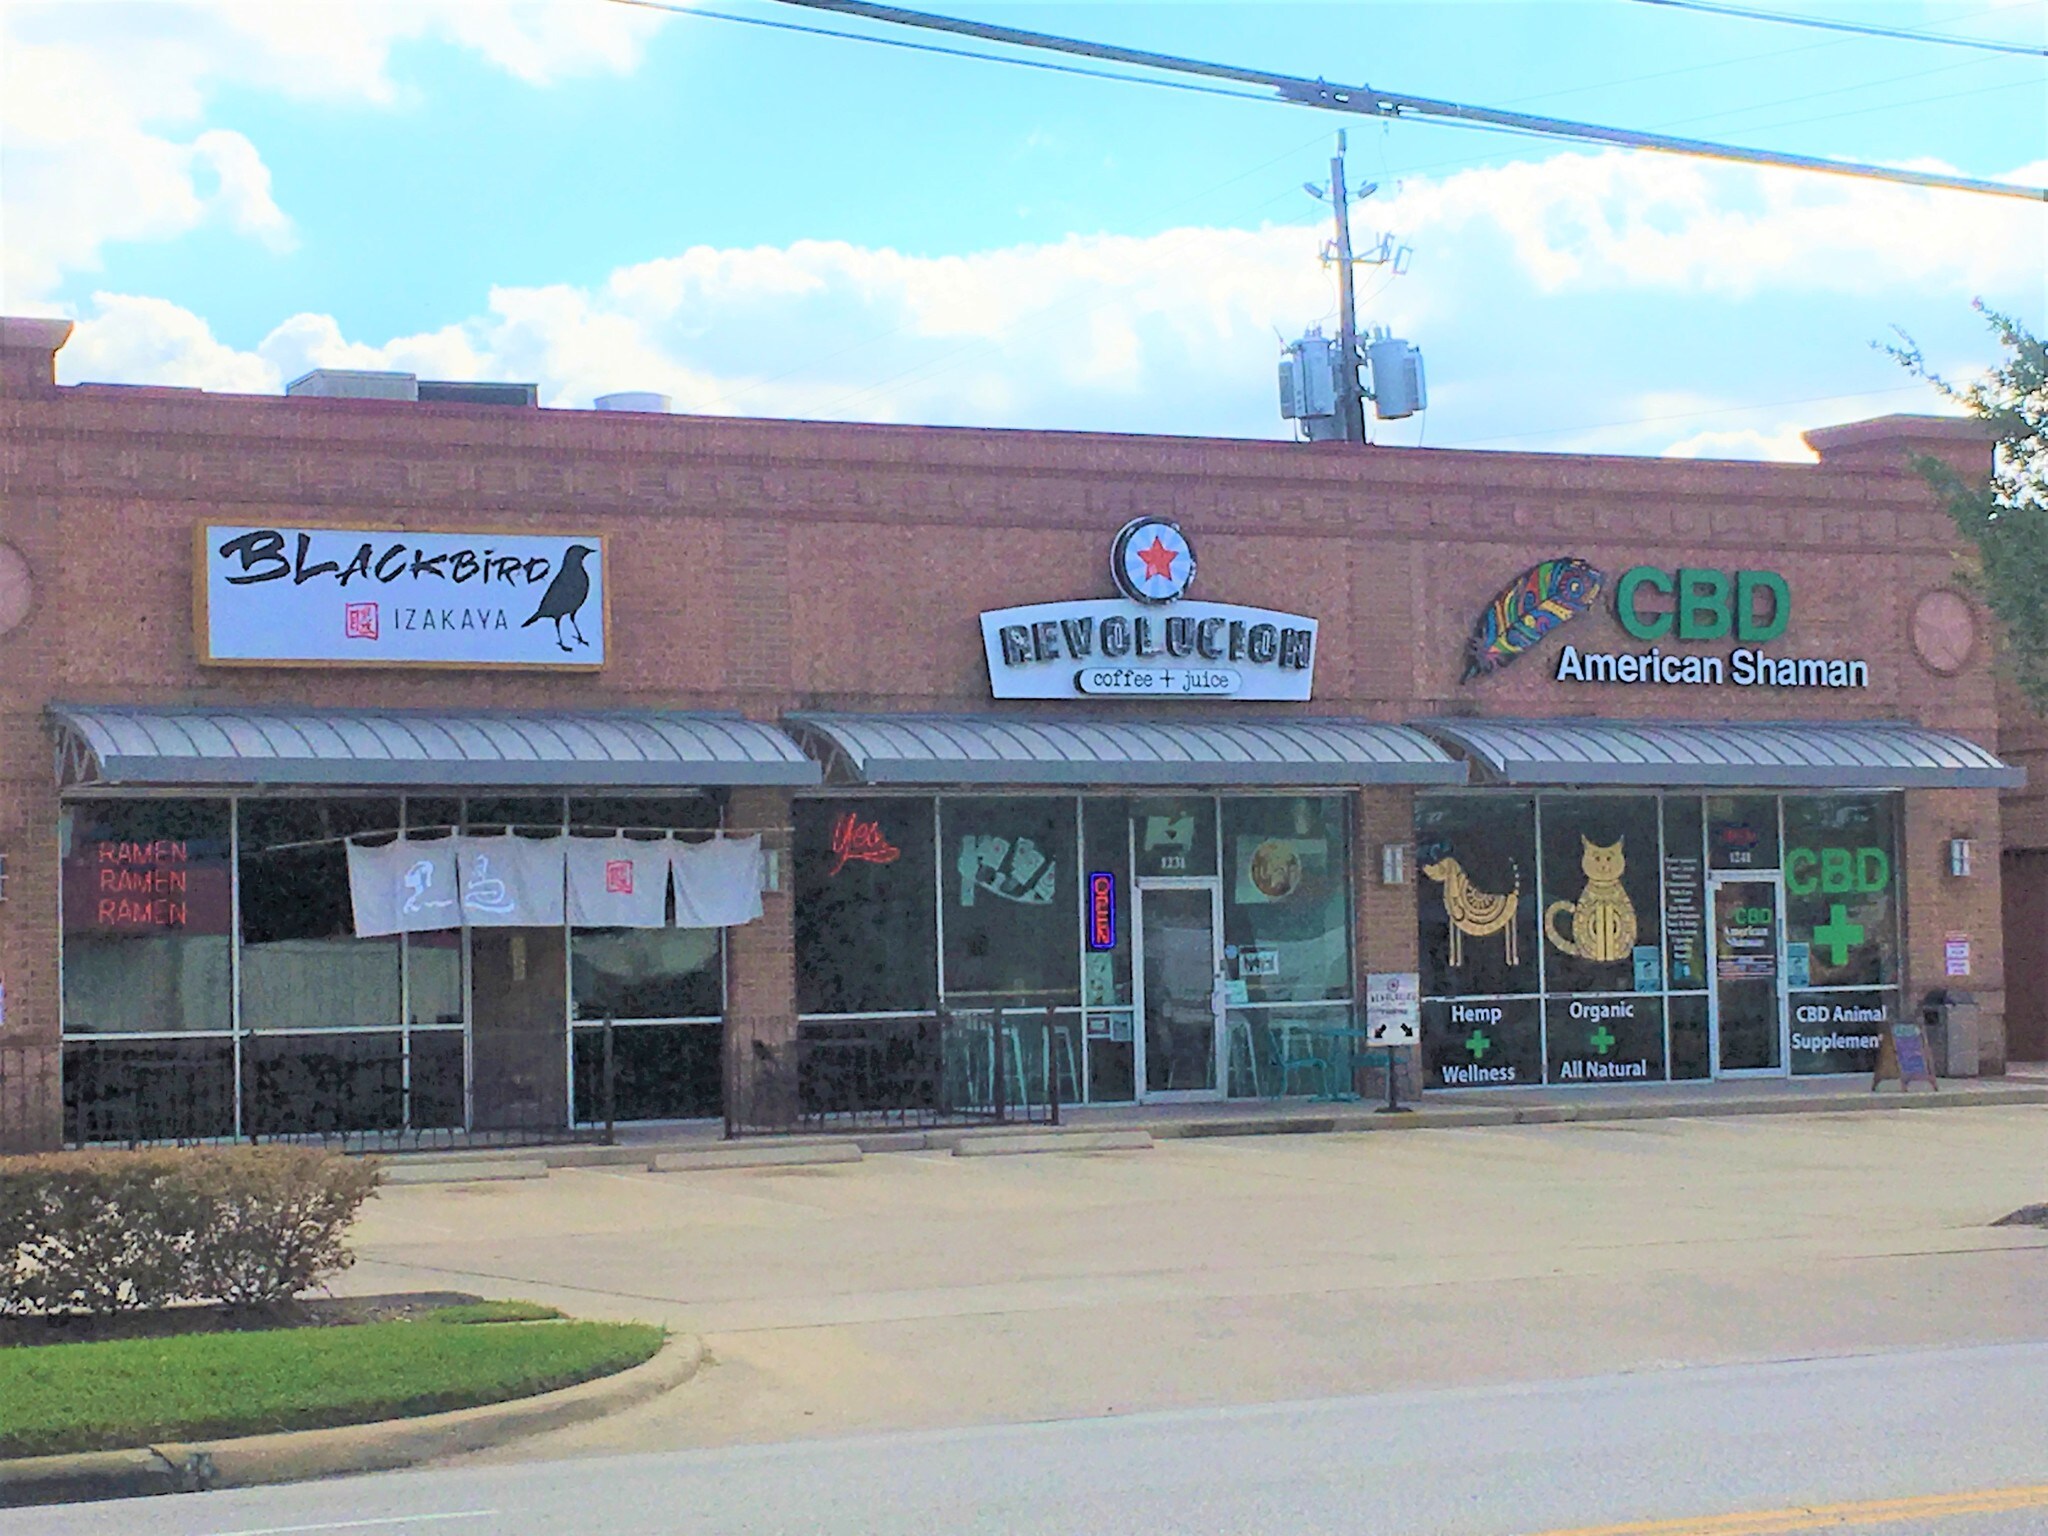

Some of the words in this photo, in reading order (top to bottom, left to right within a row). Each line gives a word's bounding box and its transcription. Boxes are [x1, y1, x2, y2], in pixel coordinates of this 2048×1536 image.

[1615, 565, 1792, 642] CBD
[394, 608, 510, 631] IZAKAYA
[999, 614, 1312, 669] REVOLUCION
[1556, 645, 1724, 685] American
[1730, 648, 1870, 688] Shaman
[1093, 668, 1153, 688] coffee
[1180, 670, 1230, 692] juice
[98, 838, 188, 866] RAMEN
[99, 868, 187, 894] RAMEN
[1785, 846, 1889, 895] CBD
[99, 898, 187, 926] RAMEN
[1094, 876, 1111, 944] OPEN
[1735, 907, 1772, 925] CBD
[1451, 1004, 1502, 1024] Hemp
[1569, 1002, 1634, 1022] Organic
[1796, 1005, 1830, 1022] CBD
[1832, 1005, 1887, 1022] Animal
[1442, 1063, 1516, 1083] Wellness
[1561, 1062, 1584, 1079] All
[1586, 1060, 1647, 1078] Natural
